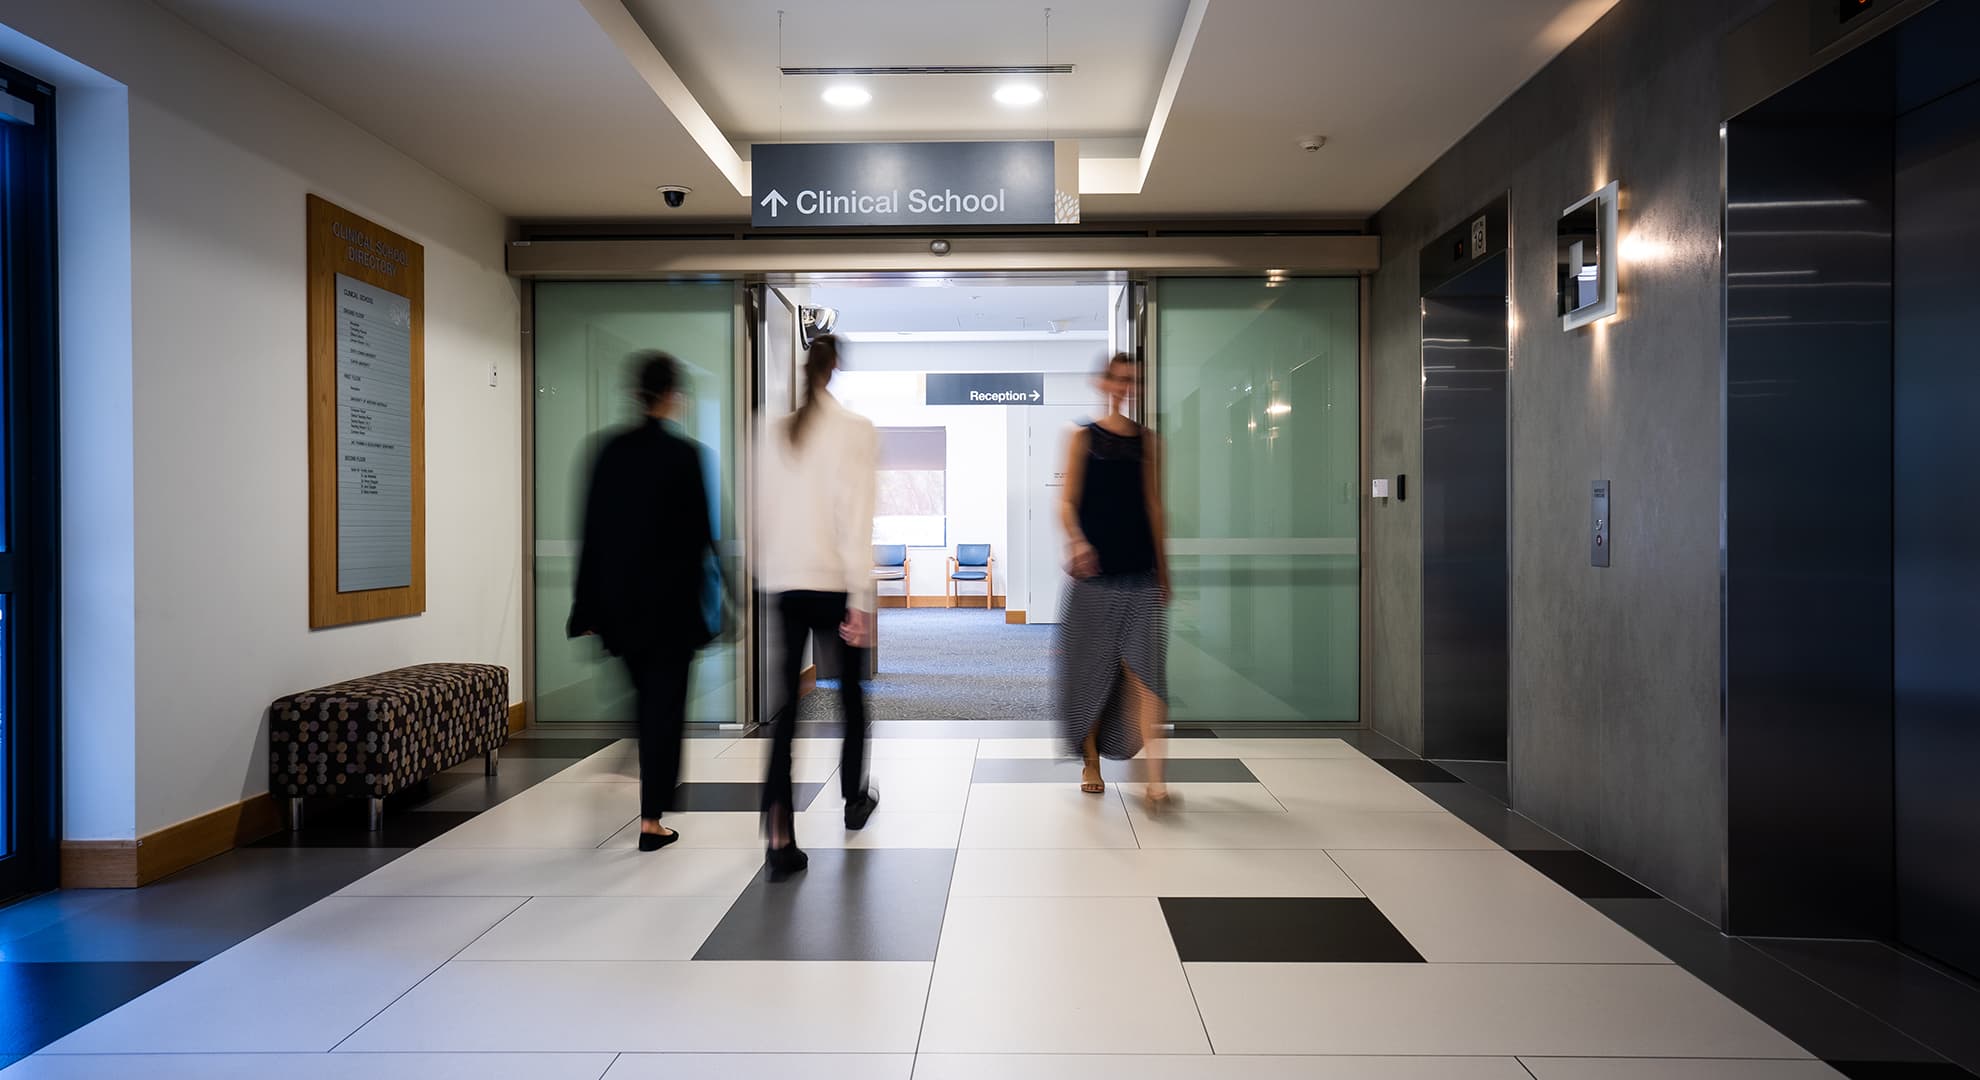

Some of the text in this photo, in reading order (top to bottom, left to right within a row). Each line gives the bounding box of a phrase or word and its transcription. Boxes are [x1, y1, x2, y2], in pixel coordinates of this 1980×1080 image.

[796, 188, 1005, 215] Clinical School
[332, 221, 409, 266] CLINICAL SCHOOL
[348, 246, 397, 276] DIRECTORY
[970, 390, 1027, 403] Reception
